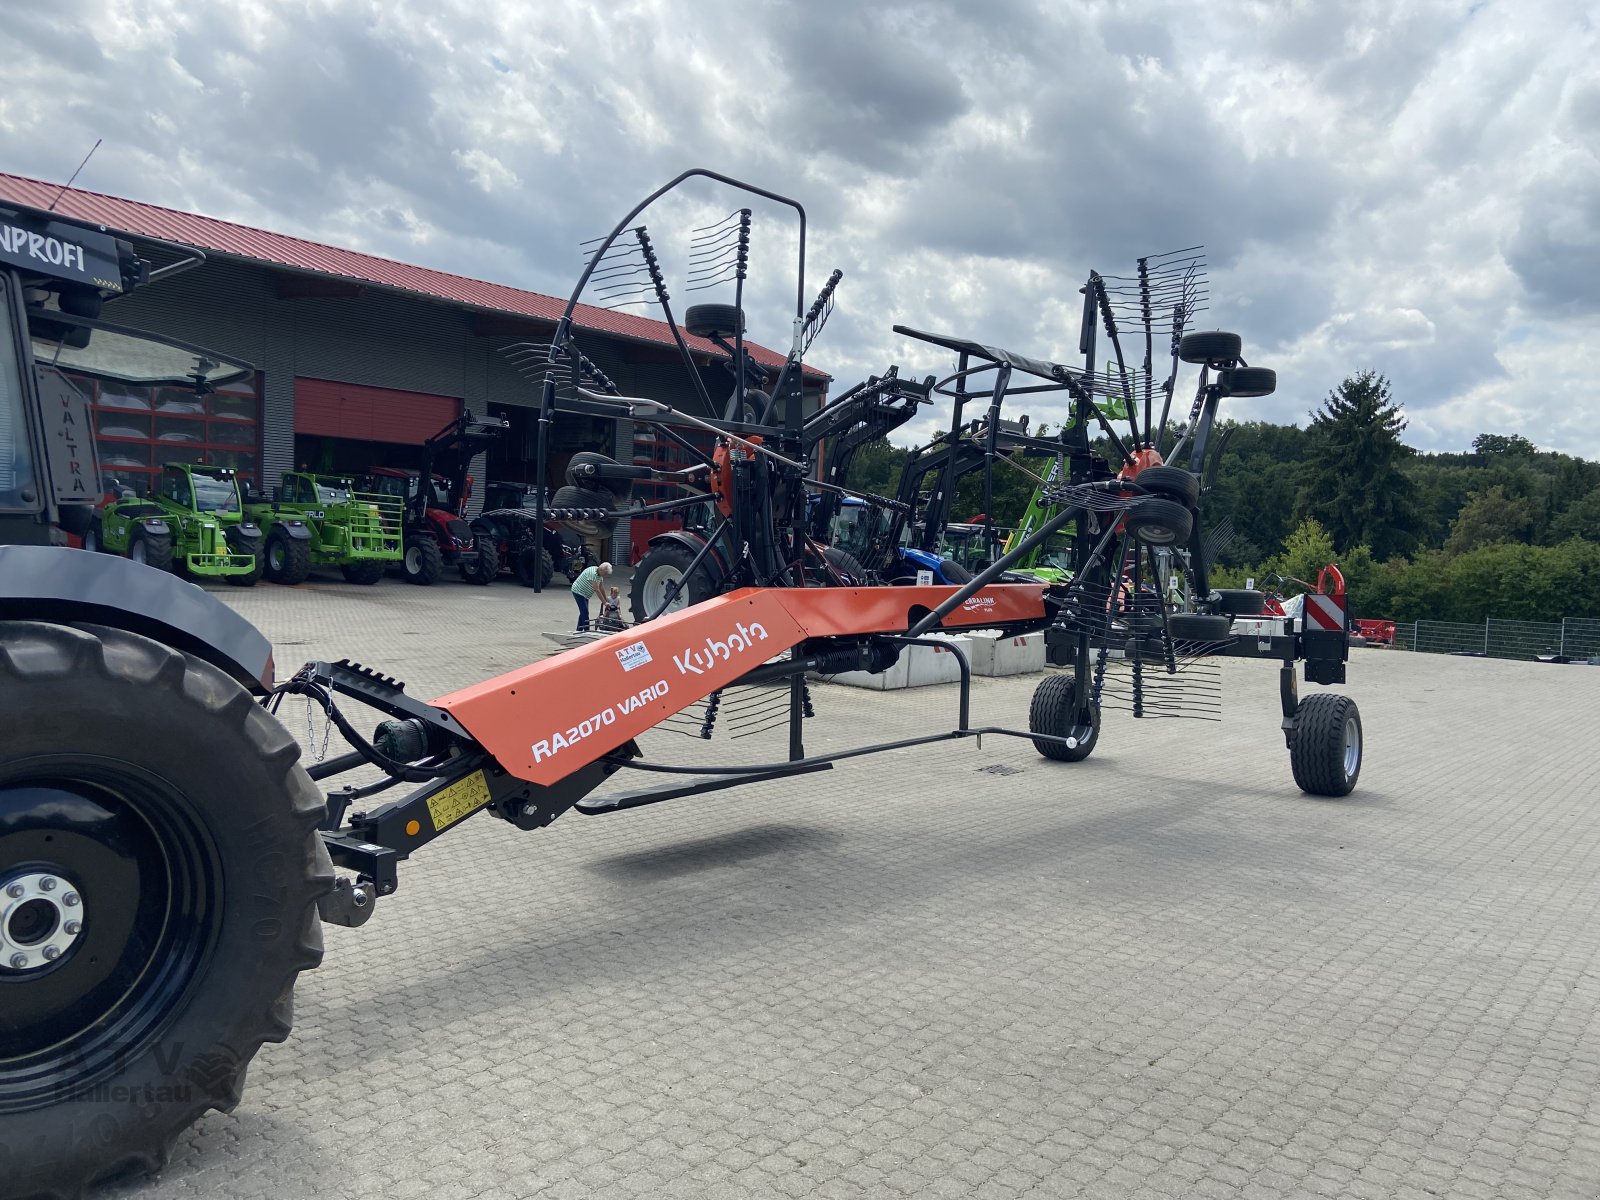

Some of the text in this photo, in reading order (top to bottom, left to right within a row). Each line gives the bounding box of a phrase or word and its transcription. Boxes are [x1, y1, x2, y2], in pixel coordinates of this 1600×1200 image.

[60, 394, 86, 493] VALTRA
[963, 597, 996, 606] ERRALINK
[672, 622, 769, 675] Kubota
[531, 679, 670, 764] RA2070 VARIO
